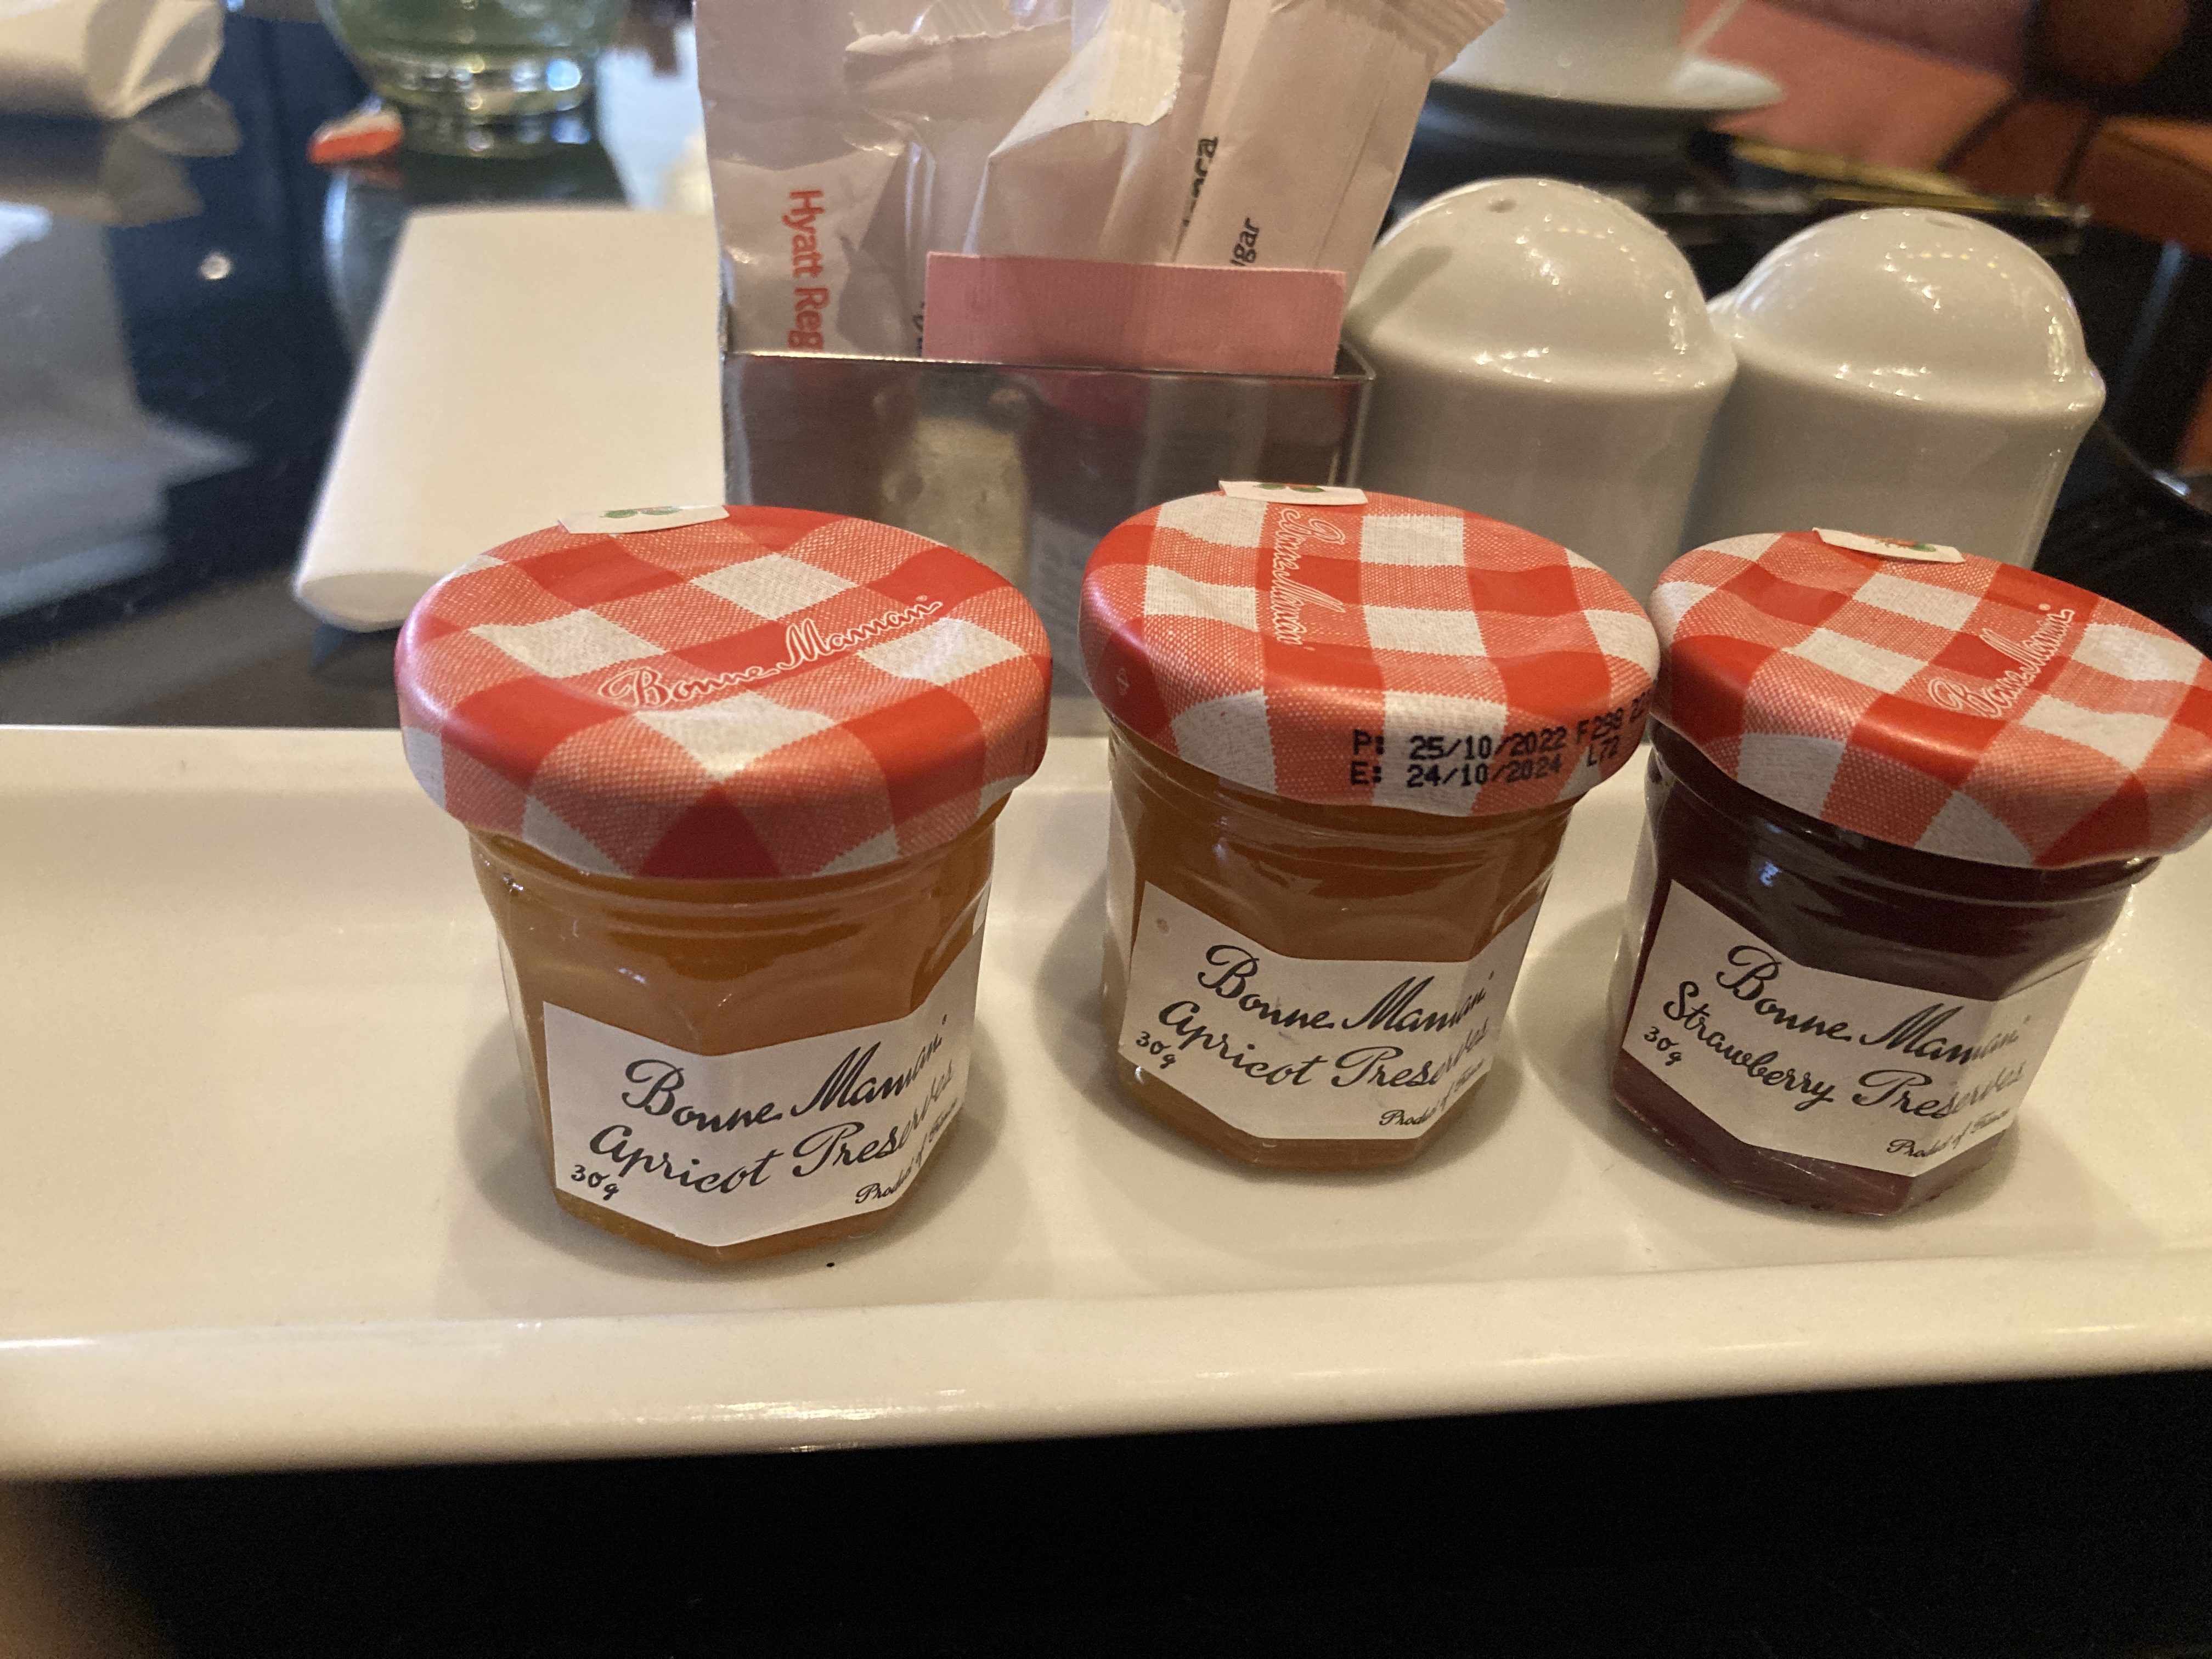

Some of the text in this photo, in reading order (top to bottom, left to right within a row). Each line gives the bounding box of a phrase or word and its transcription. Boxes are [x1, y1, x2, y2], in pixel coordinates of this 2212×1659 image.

[781, 189, 825, 278] Hyatt
[597, 601, 943, 708] Bonne Maman
[1350, 760, 1382, 786] E:
[1406, 752, 1563, 788] 24/10/2024
[1352, 729, 1385, 755] P:
[1408, 726, 1568, 761] 25/10/2022
[1197, 944, 1486, 1032] Bonne Maman
[1716, 945, 2019, 1065] Bonne Maman
[622, 1034, 942, 1133] Bonne Maman
[1135, 1031, 1177, 1069] 30g
[1158, 1000, 1329, 1087] Apricot
[1331, 1017, 1489, 1087] Preserves
[1644, 1026, 1682, 1066] 30g
[1663, 980, 2027, 1119] Strawberry Preserves
[590, 1124, 785, 1193] Apricot
[792, 1059, 952, 1180] Preserves
[571, 1164, 620, 1201] 30g
